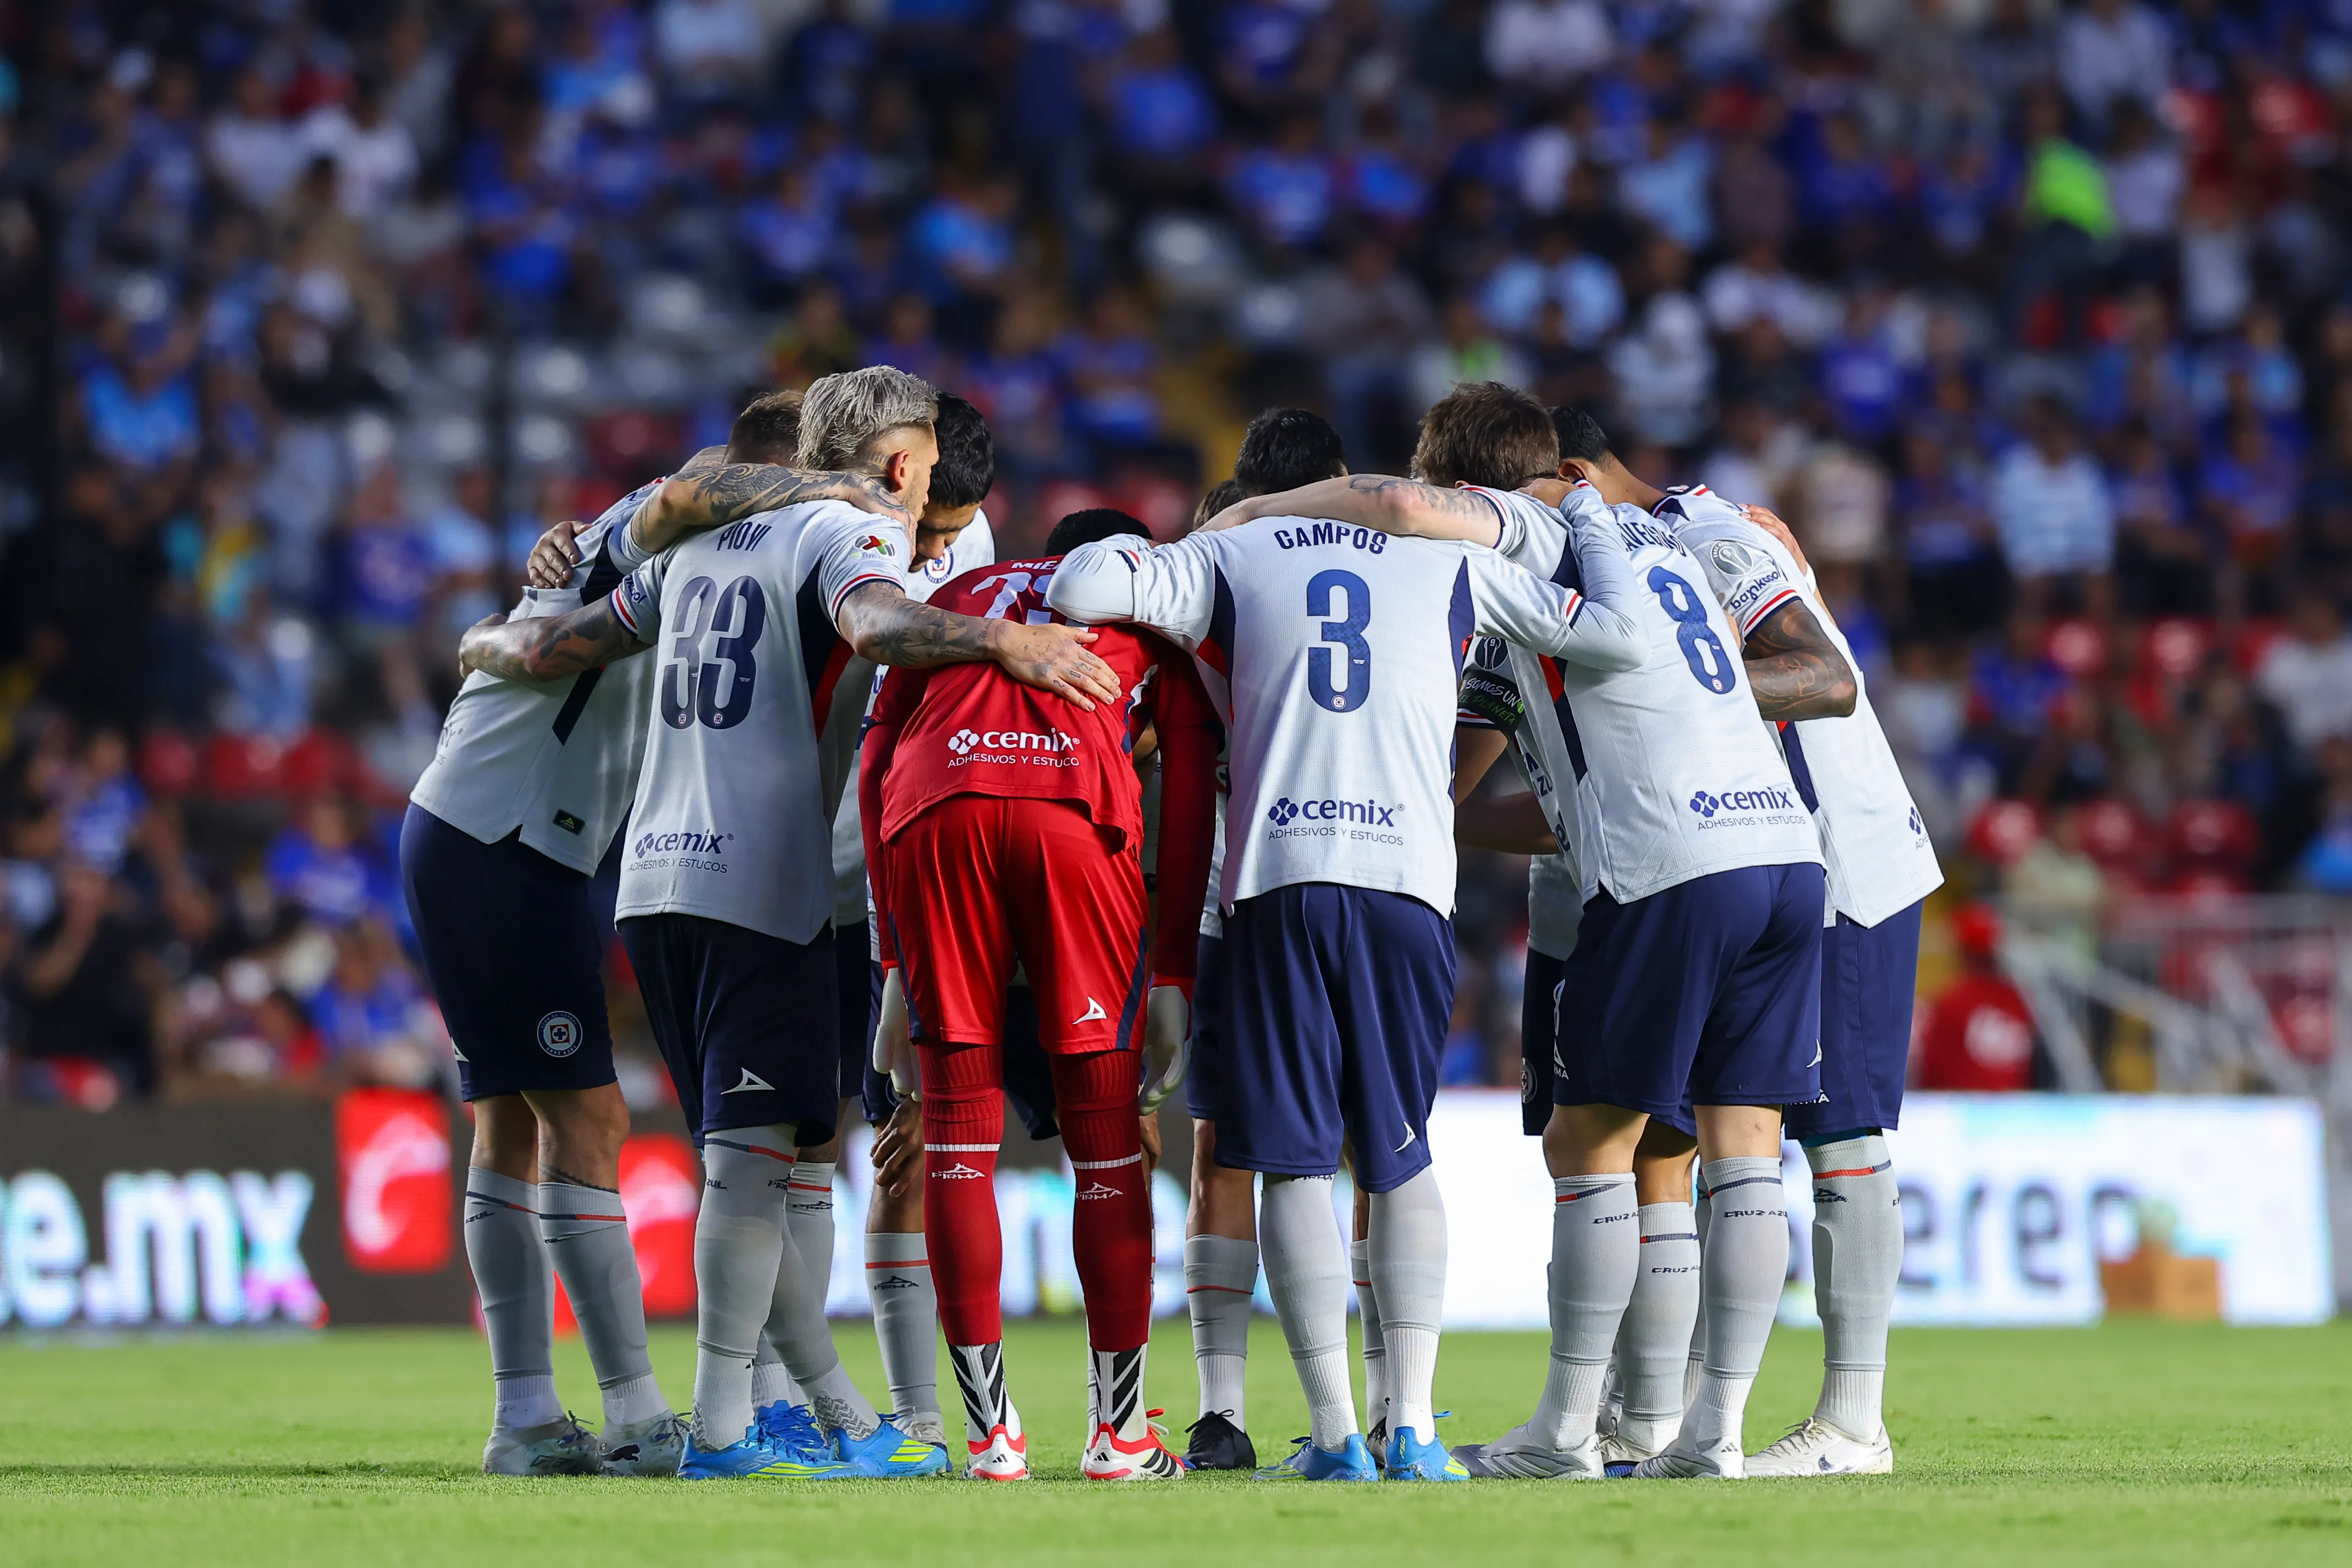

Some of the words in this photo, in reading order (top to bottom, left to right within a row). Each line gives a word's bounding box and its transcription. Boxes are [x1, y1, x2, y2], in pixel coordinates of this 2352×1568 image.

[1274, 522, 1387, 554] CAMPOS
[1011, 560, 1060, 570] MIE
[1647, 566, 1736, 694] 8
[1306, 569, 1371, 713] 3
[661, 575, 766, 730] 33
[1465, 678, 1506, 695] SOMOS
[947, 753, 1016, 768] ADHESIVOS
[1021, 755, 1029, 764] Y
[1698, 817, 1756, 831] ADHESIVOS
[1757, 817, 1764, 825] Y
[1767, 815, 1806, 825] ESTUCOS
[1268, 827, 1336, 840] ADHESIVOS
[1340, 827, 1347, 837] Y
[1350, 830, 1404, 845] ESTUCOS
[628, 858, 670, 872] ADHESIVOS
[672, 858, 678, 866] Y
[679, 858, 728, 873] ESTUCOS
[1593, 1214, 1629, 1224] CRUZ
[1724, 1210, 1765, 1218] CRUZ
